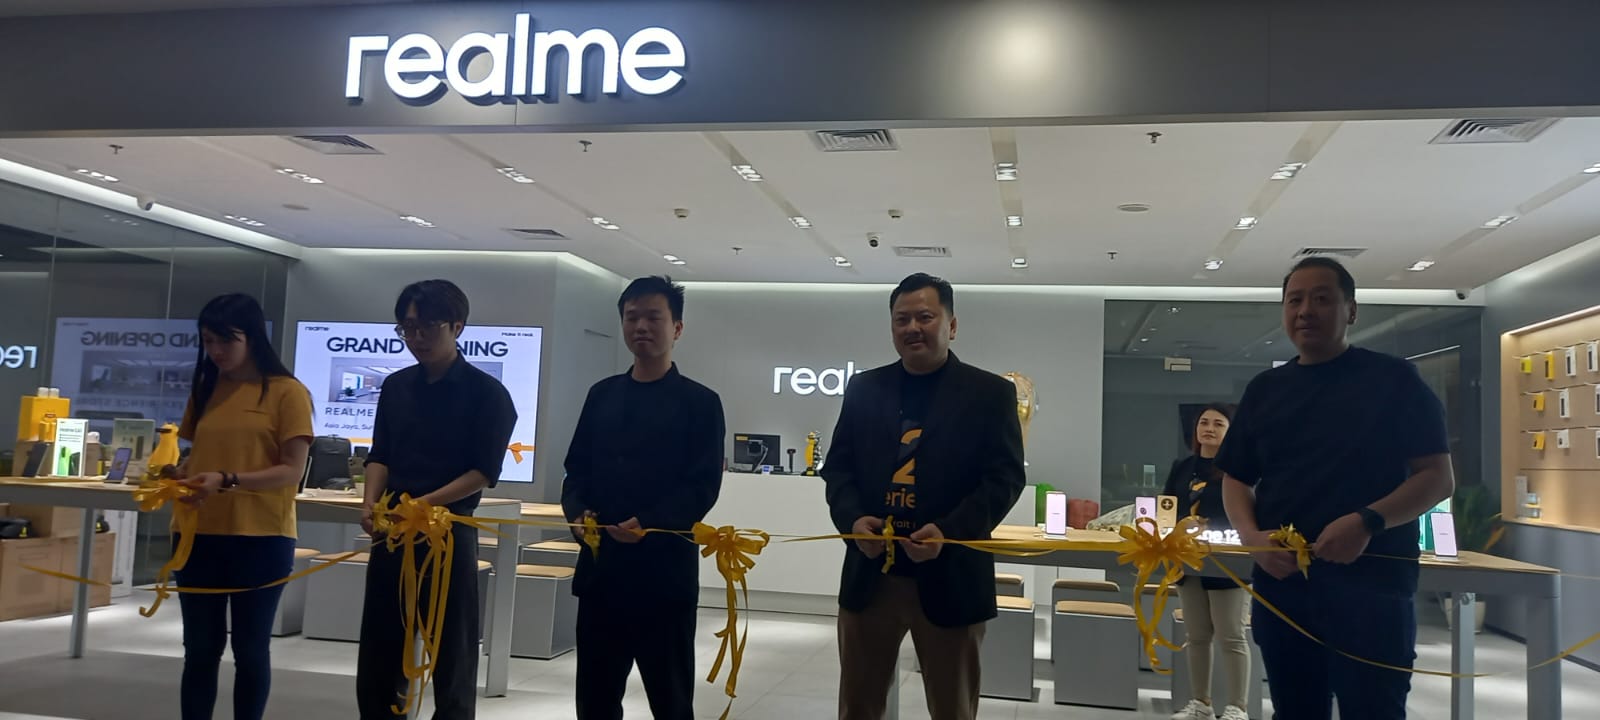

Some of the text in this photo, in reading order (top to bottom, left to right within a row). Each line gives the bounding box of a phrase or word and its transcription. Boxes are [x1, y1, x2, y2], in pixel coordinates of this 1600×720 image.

[345, 13, 686, 99] realme
[327, 337, 508, 357] GRAND NING
[773, 361, 868, 396] real
[325, 407, 374, 417] REALME
[892, 428, 923, 485] 2
